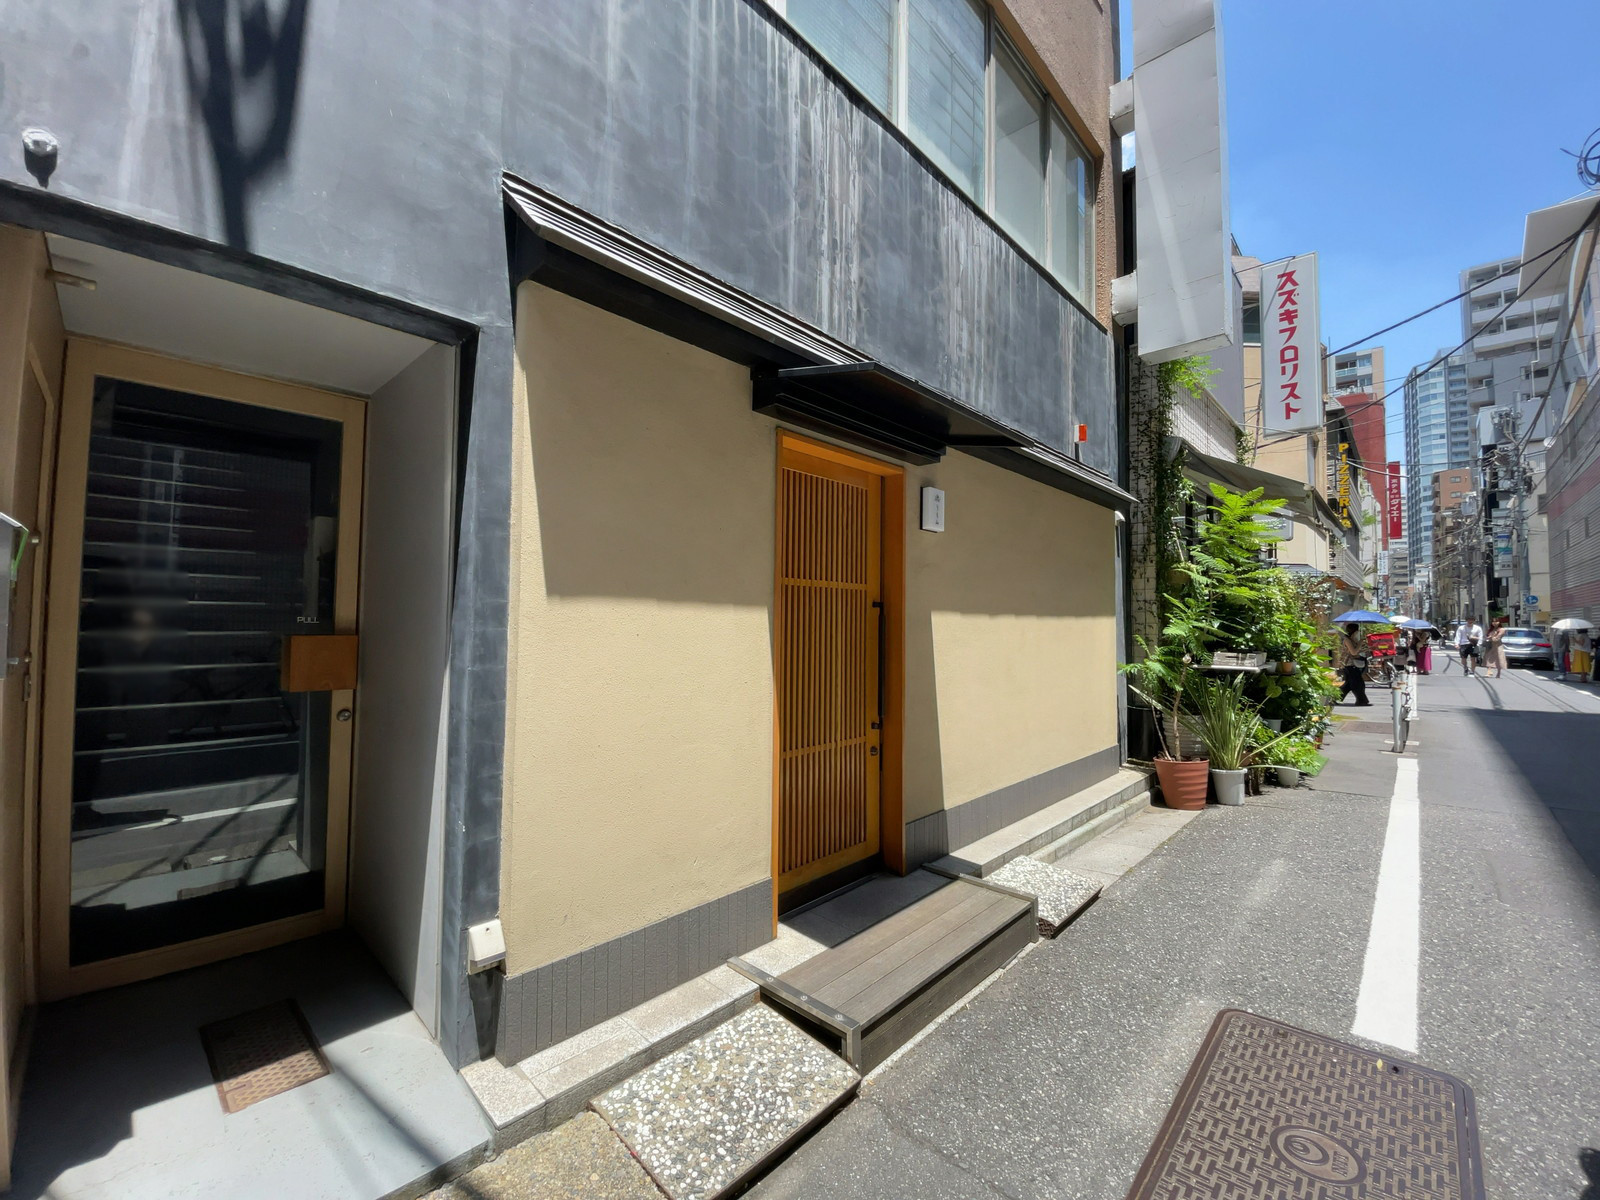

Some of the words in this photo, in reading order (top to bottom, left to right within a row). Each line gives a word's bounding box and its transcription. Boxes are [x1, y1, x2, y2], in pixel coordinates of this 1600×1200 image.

[1276, 269, 1302, 420] スズキフロリスト
[296, 616, 320, 624] PULL
